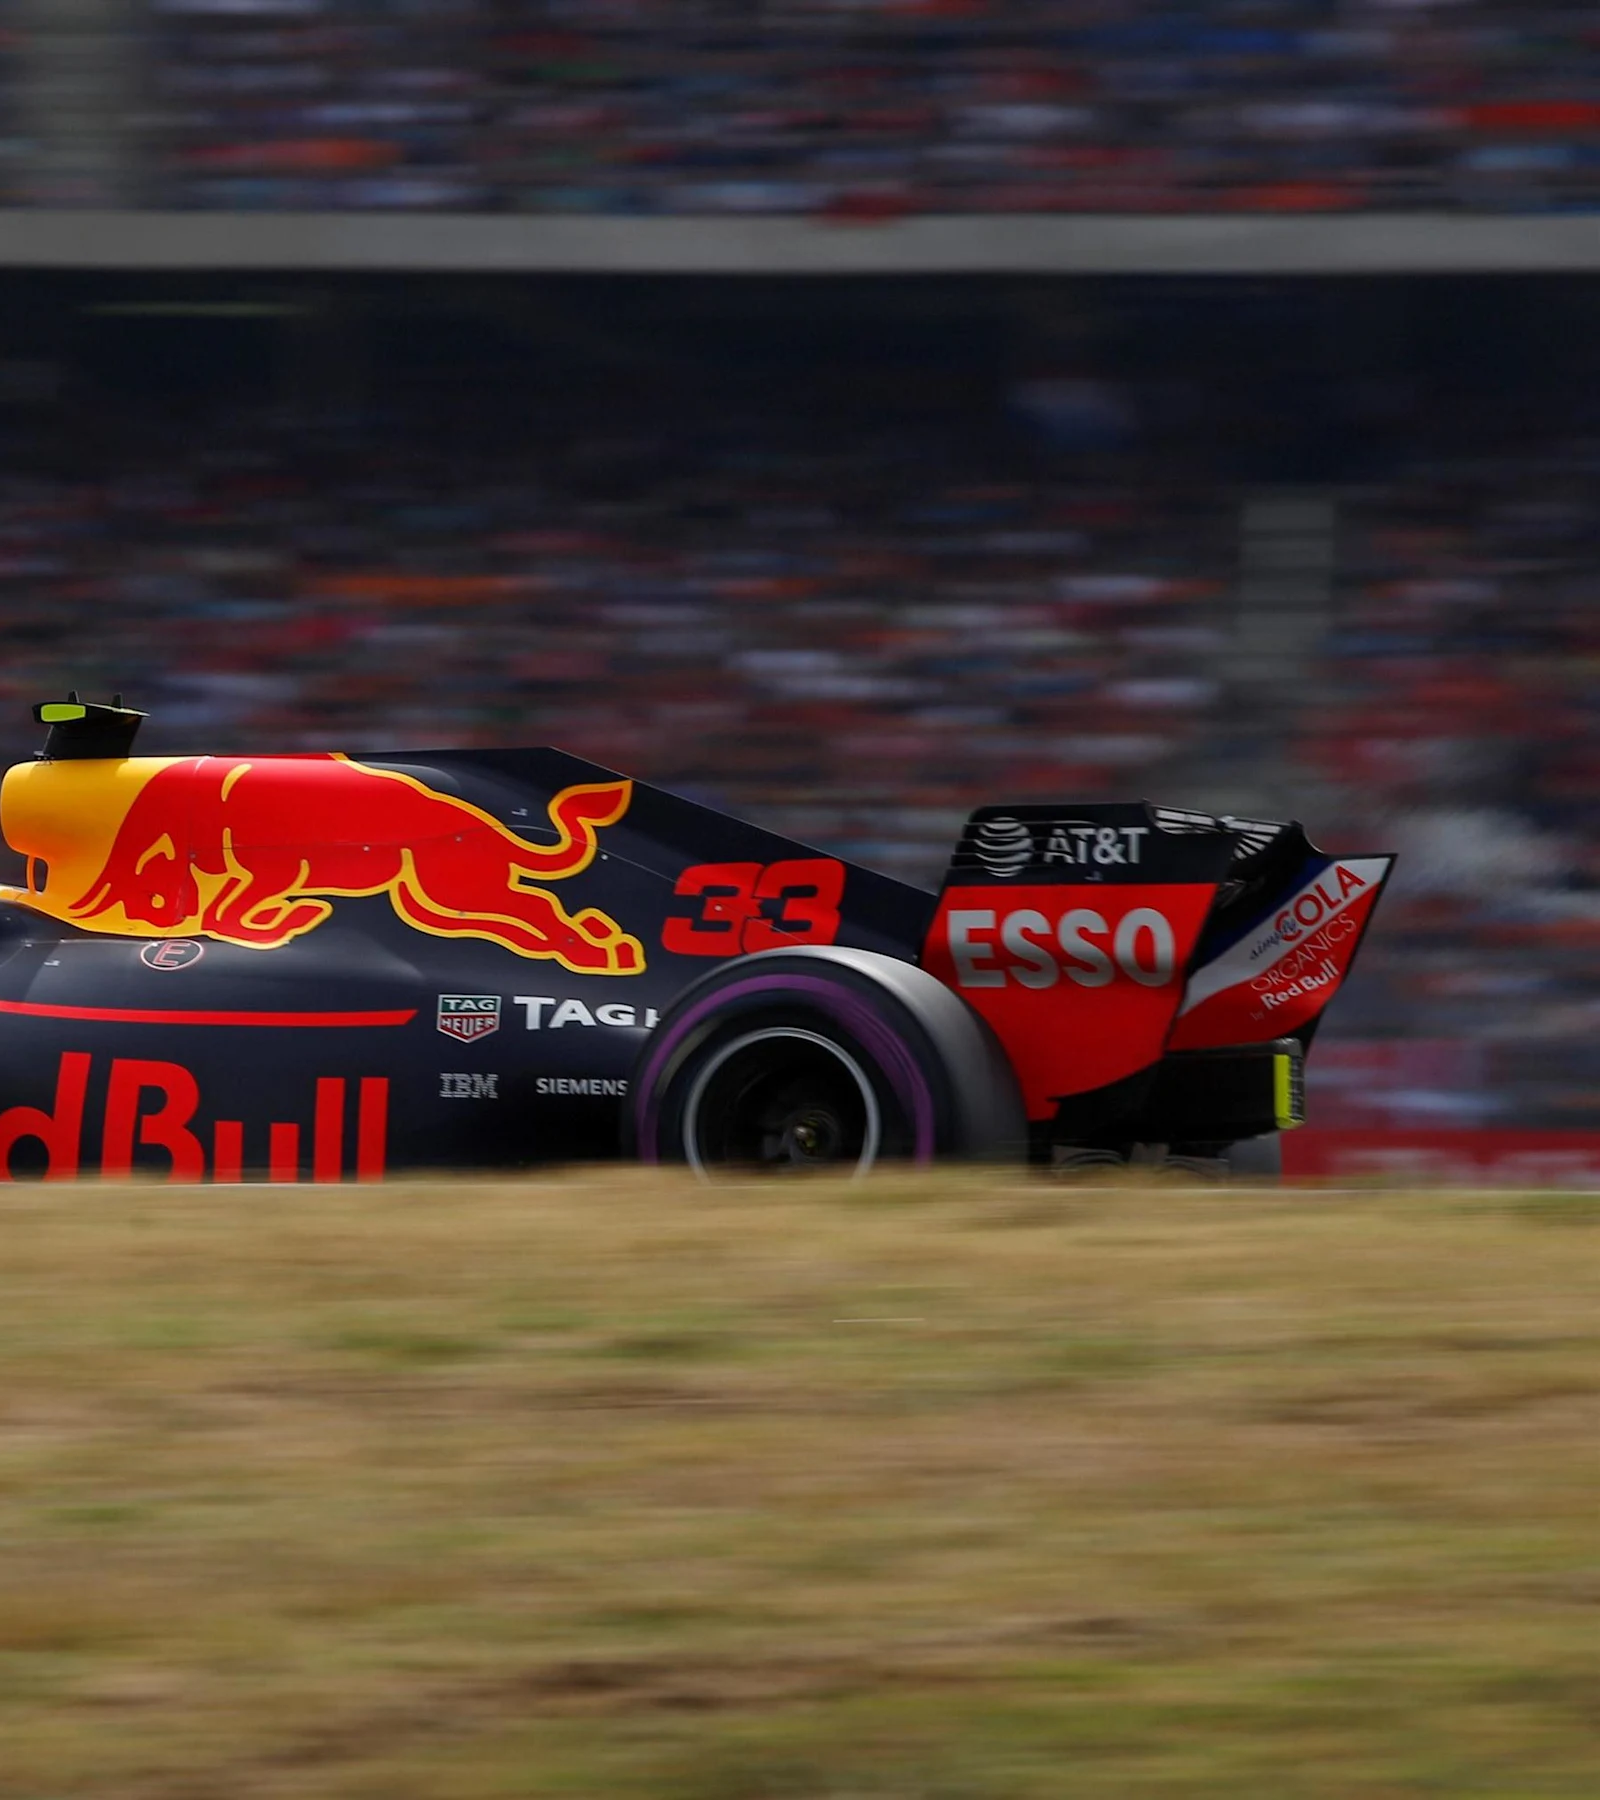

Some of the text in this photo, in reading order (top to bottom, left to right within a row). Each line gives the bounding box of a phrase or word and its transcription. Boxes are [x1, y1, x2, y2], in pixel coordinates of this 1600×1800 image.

[1043, 826, 1149, 866] AT&T
[661, 857, 847, 958] 33
[1274, 864, 1367, 942] COLA
[947, 907, 1176, 989] ESSO
[1250, 912, 1357, 992] ORGANICS
[443, 998, 496, 1011] TAG
[513, 995, 637, 1031] TAG
[440, 1016, 496, 1037] HEUER
[439, 1072, 499, 1099] IBM
[535, 1077, 629, 1097] SIEMENS
